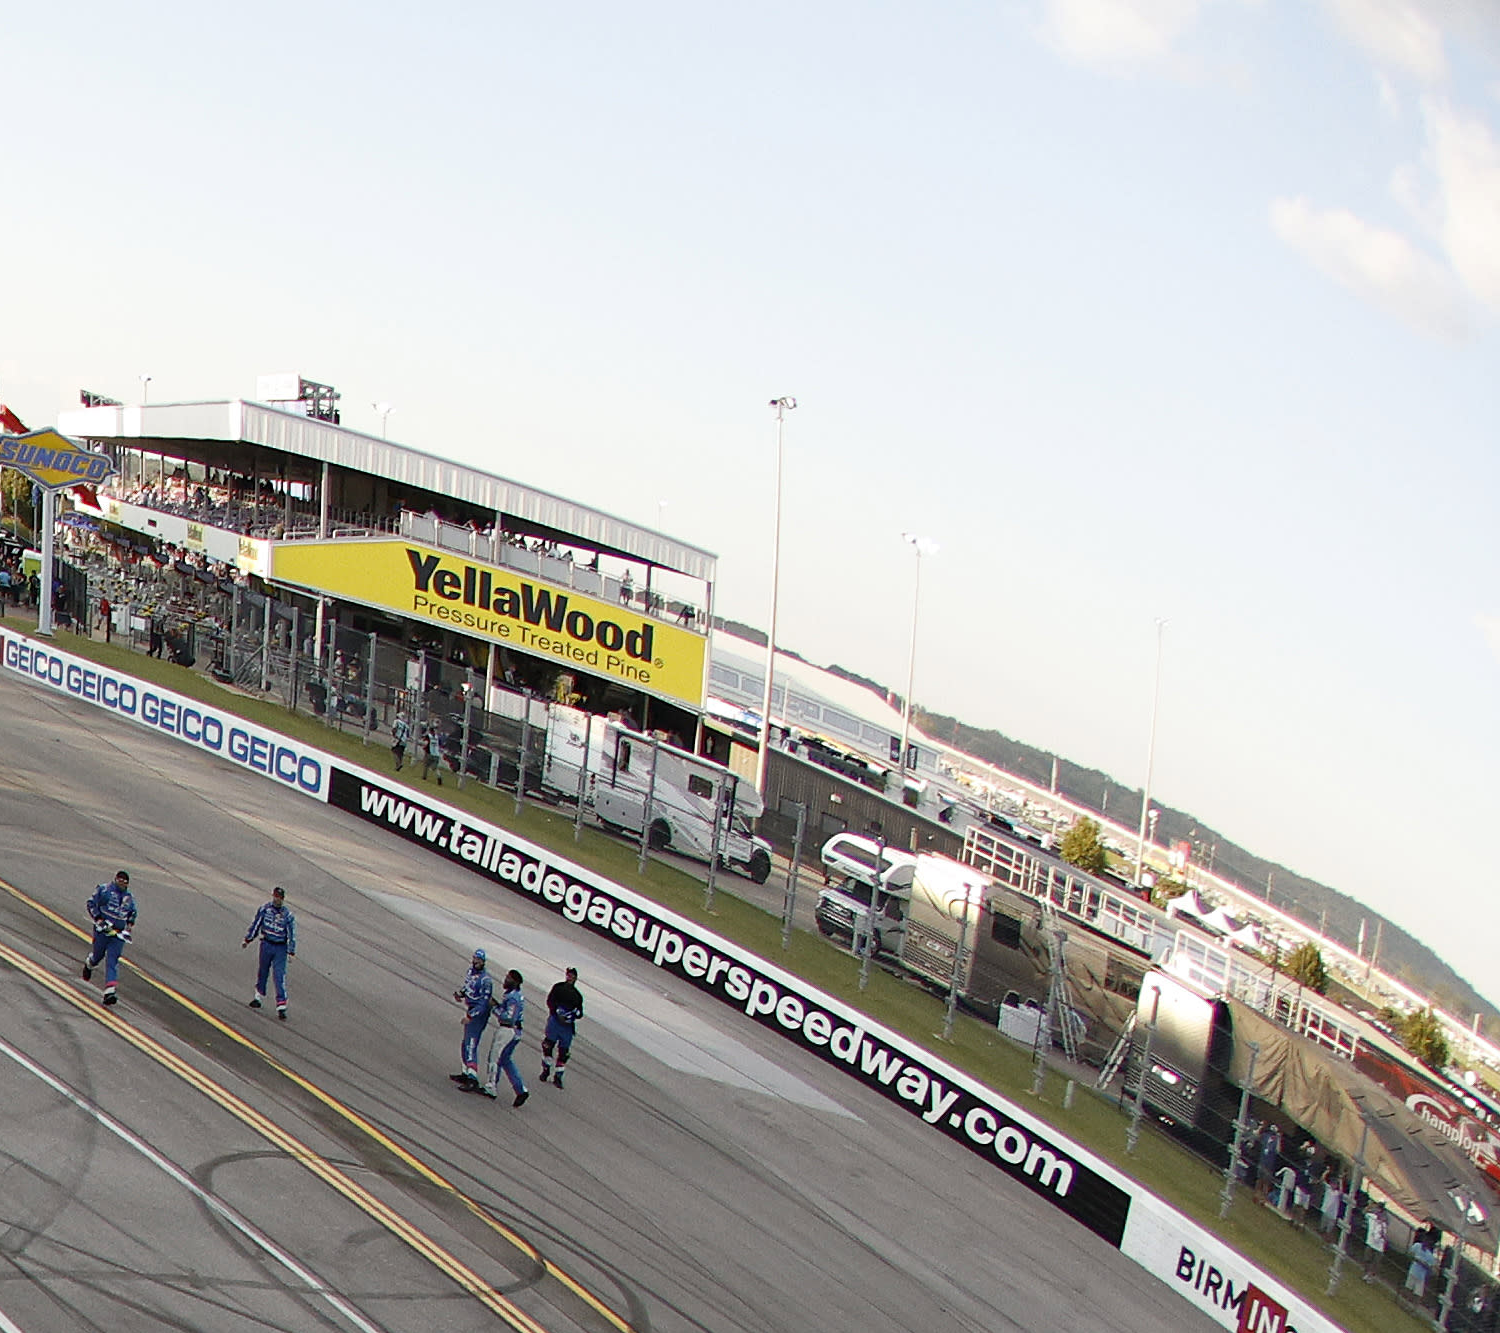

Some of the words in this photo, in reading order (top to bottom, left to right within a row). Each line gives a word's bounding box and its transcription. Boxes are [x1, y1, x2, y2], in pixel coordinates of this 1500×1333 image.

[405, 548, 655, 662] YellaWood
[413, 596, 510, 639] Pressure
[516, 629, 599, 666] Treated
[606, 654, 651, 683] Pine
[5, 641, 63, 687] GEICO
[67, 664, 136, 715] GEICO
[142, 693, 223, 751] GEICO
[228, 728, 321, 793] GEICO
[359, 784, 1074, 1197] www.talladegasuperspeedway.com
